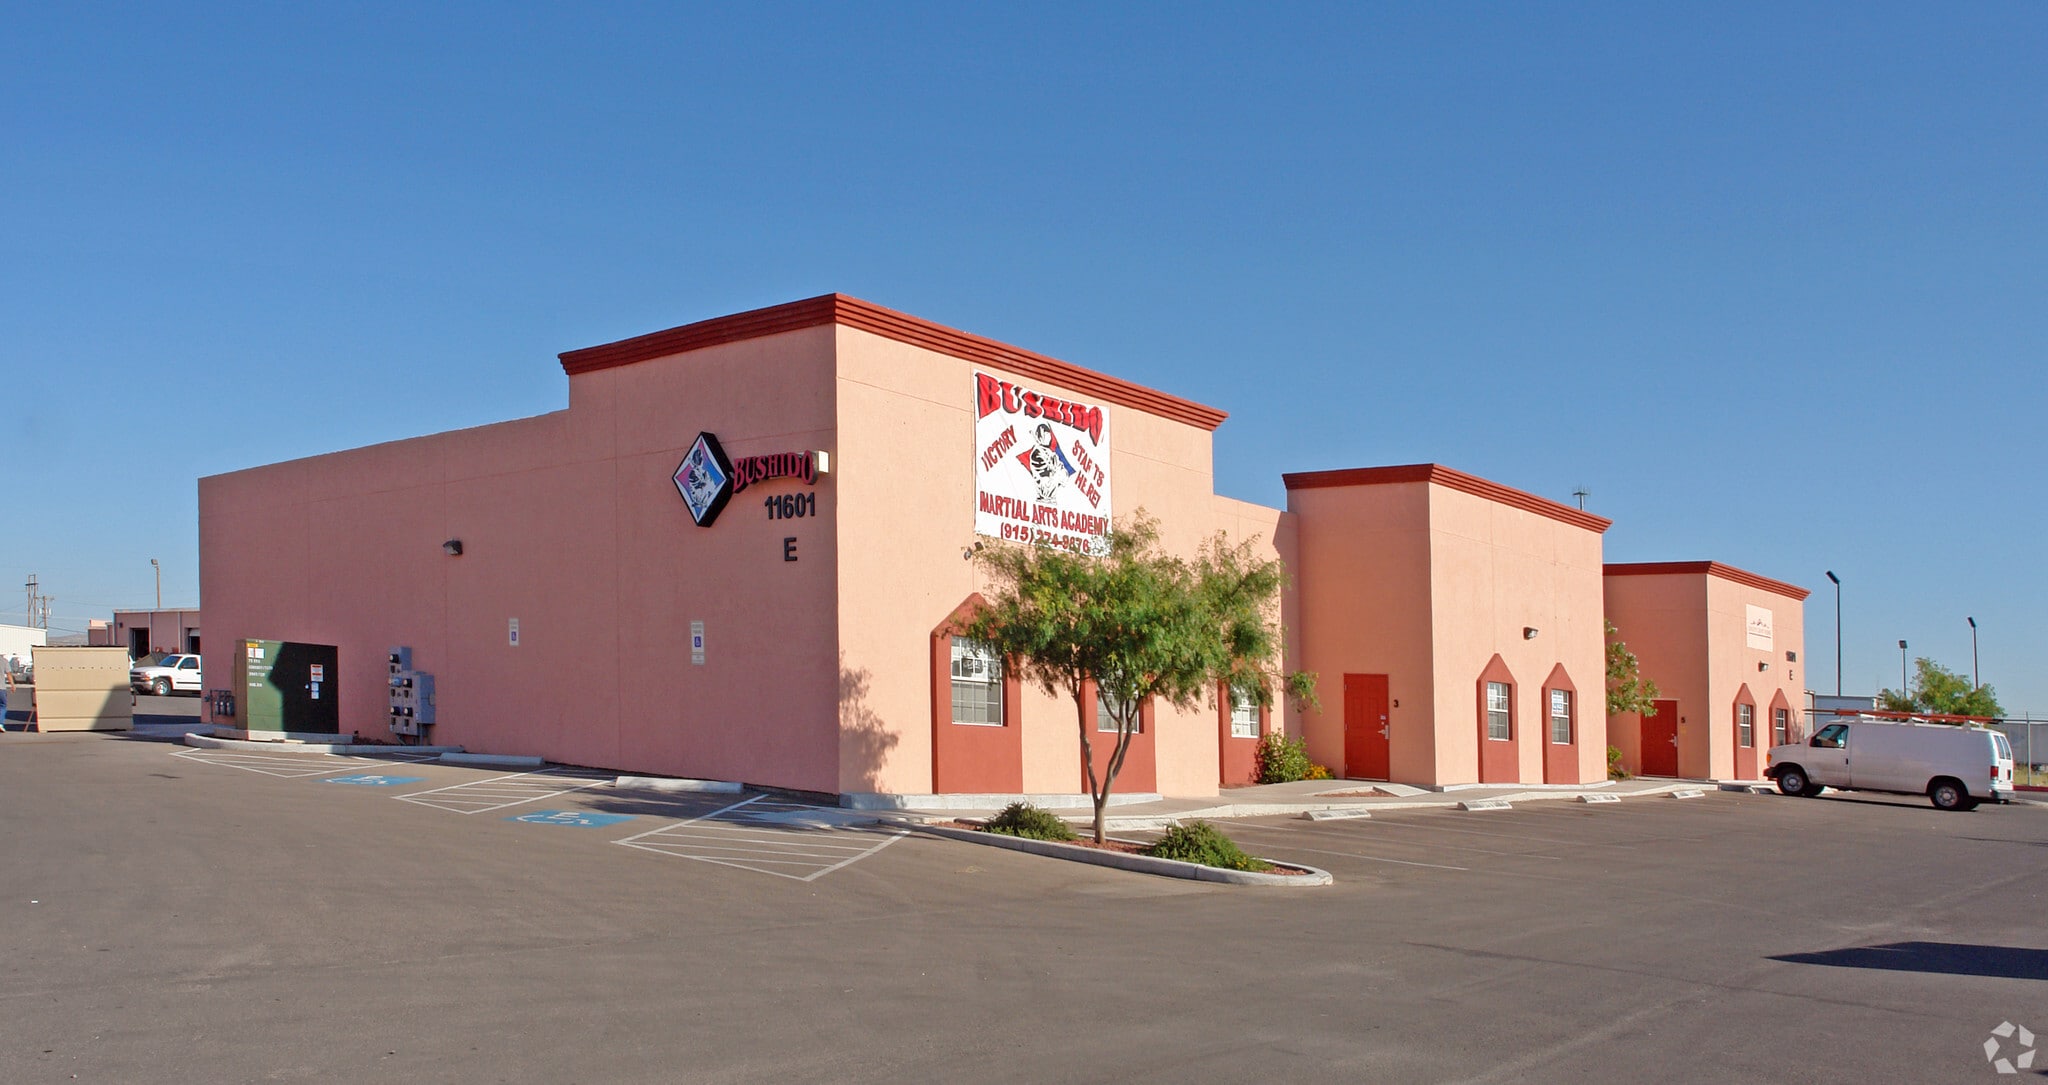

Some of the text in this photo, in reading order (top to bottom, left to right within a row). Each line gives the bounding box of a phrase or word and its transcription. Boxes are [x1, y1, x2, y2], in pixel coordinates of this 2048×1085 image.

[975, 372, 1103, 447] BUSHIDO
[733, 450, 816, 493] BUSHIDO
[765, 492, 816, 520] 11601
[979, 490, 1109, 537] MARTIAL ARTS ACADEMY
[1001, 522, 1033, 545] (915)
[784, 537, 798, 562] E
[1393, 699, 1399, 708] 3
